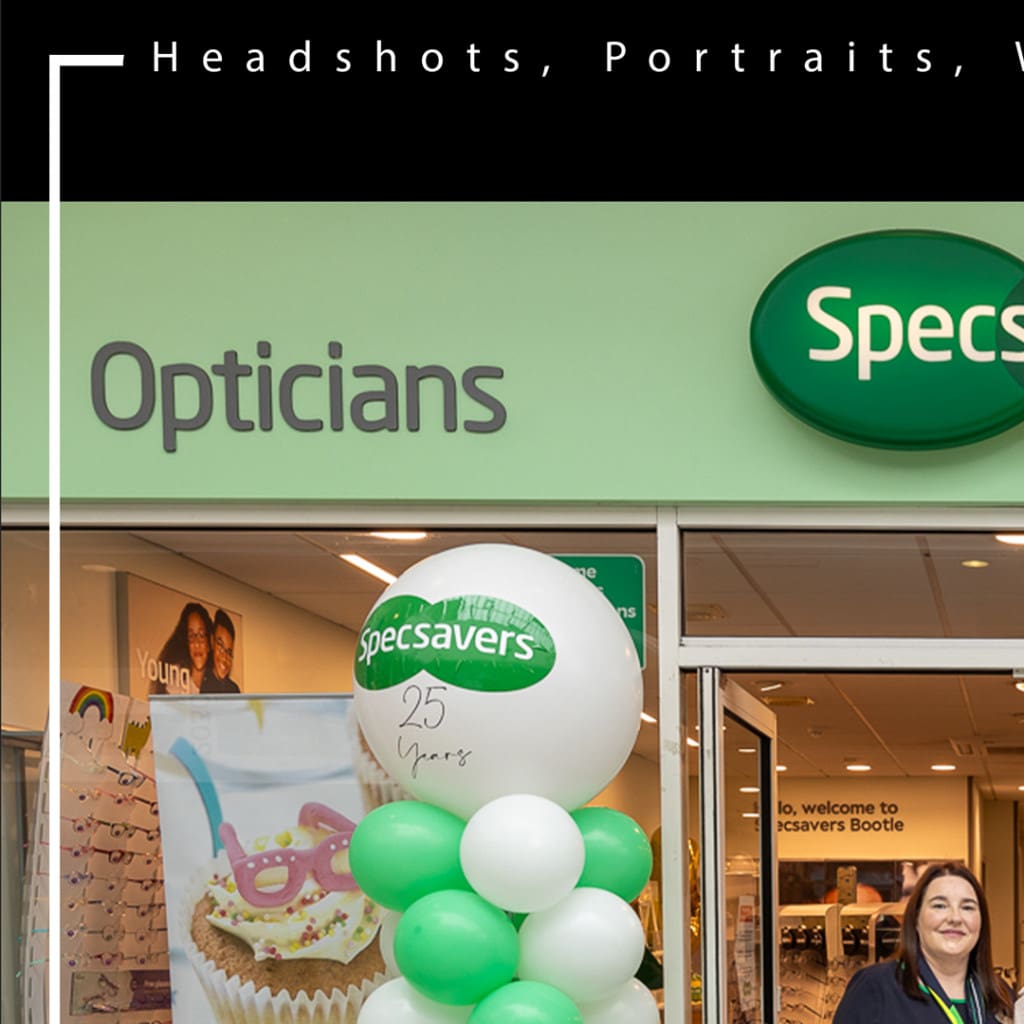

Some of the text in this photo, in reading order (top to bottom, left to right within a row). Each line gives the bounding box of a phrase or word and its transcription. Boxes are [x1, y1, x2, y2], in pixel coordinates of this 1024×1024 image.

[90, 340, 507, 453] Opticians
[357, 622, 535, 666] Specsavers
[136, 648, 191, 694] Young
[398, 684, 448, 730] 25
[396, 735, 473, 779] Years
[776, 817, 904, 832] ecsavers Bootle
[802, 801, 875, 815] welcome
[880, 802, 899, 815] to
